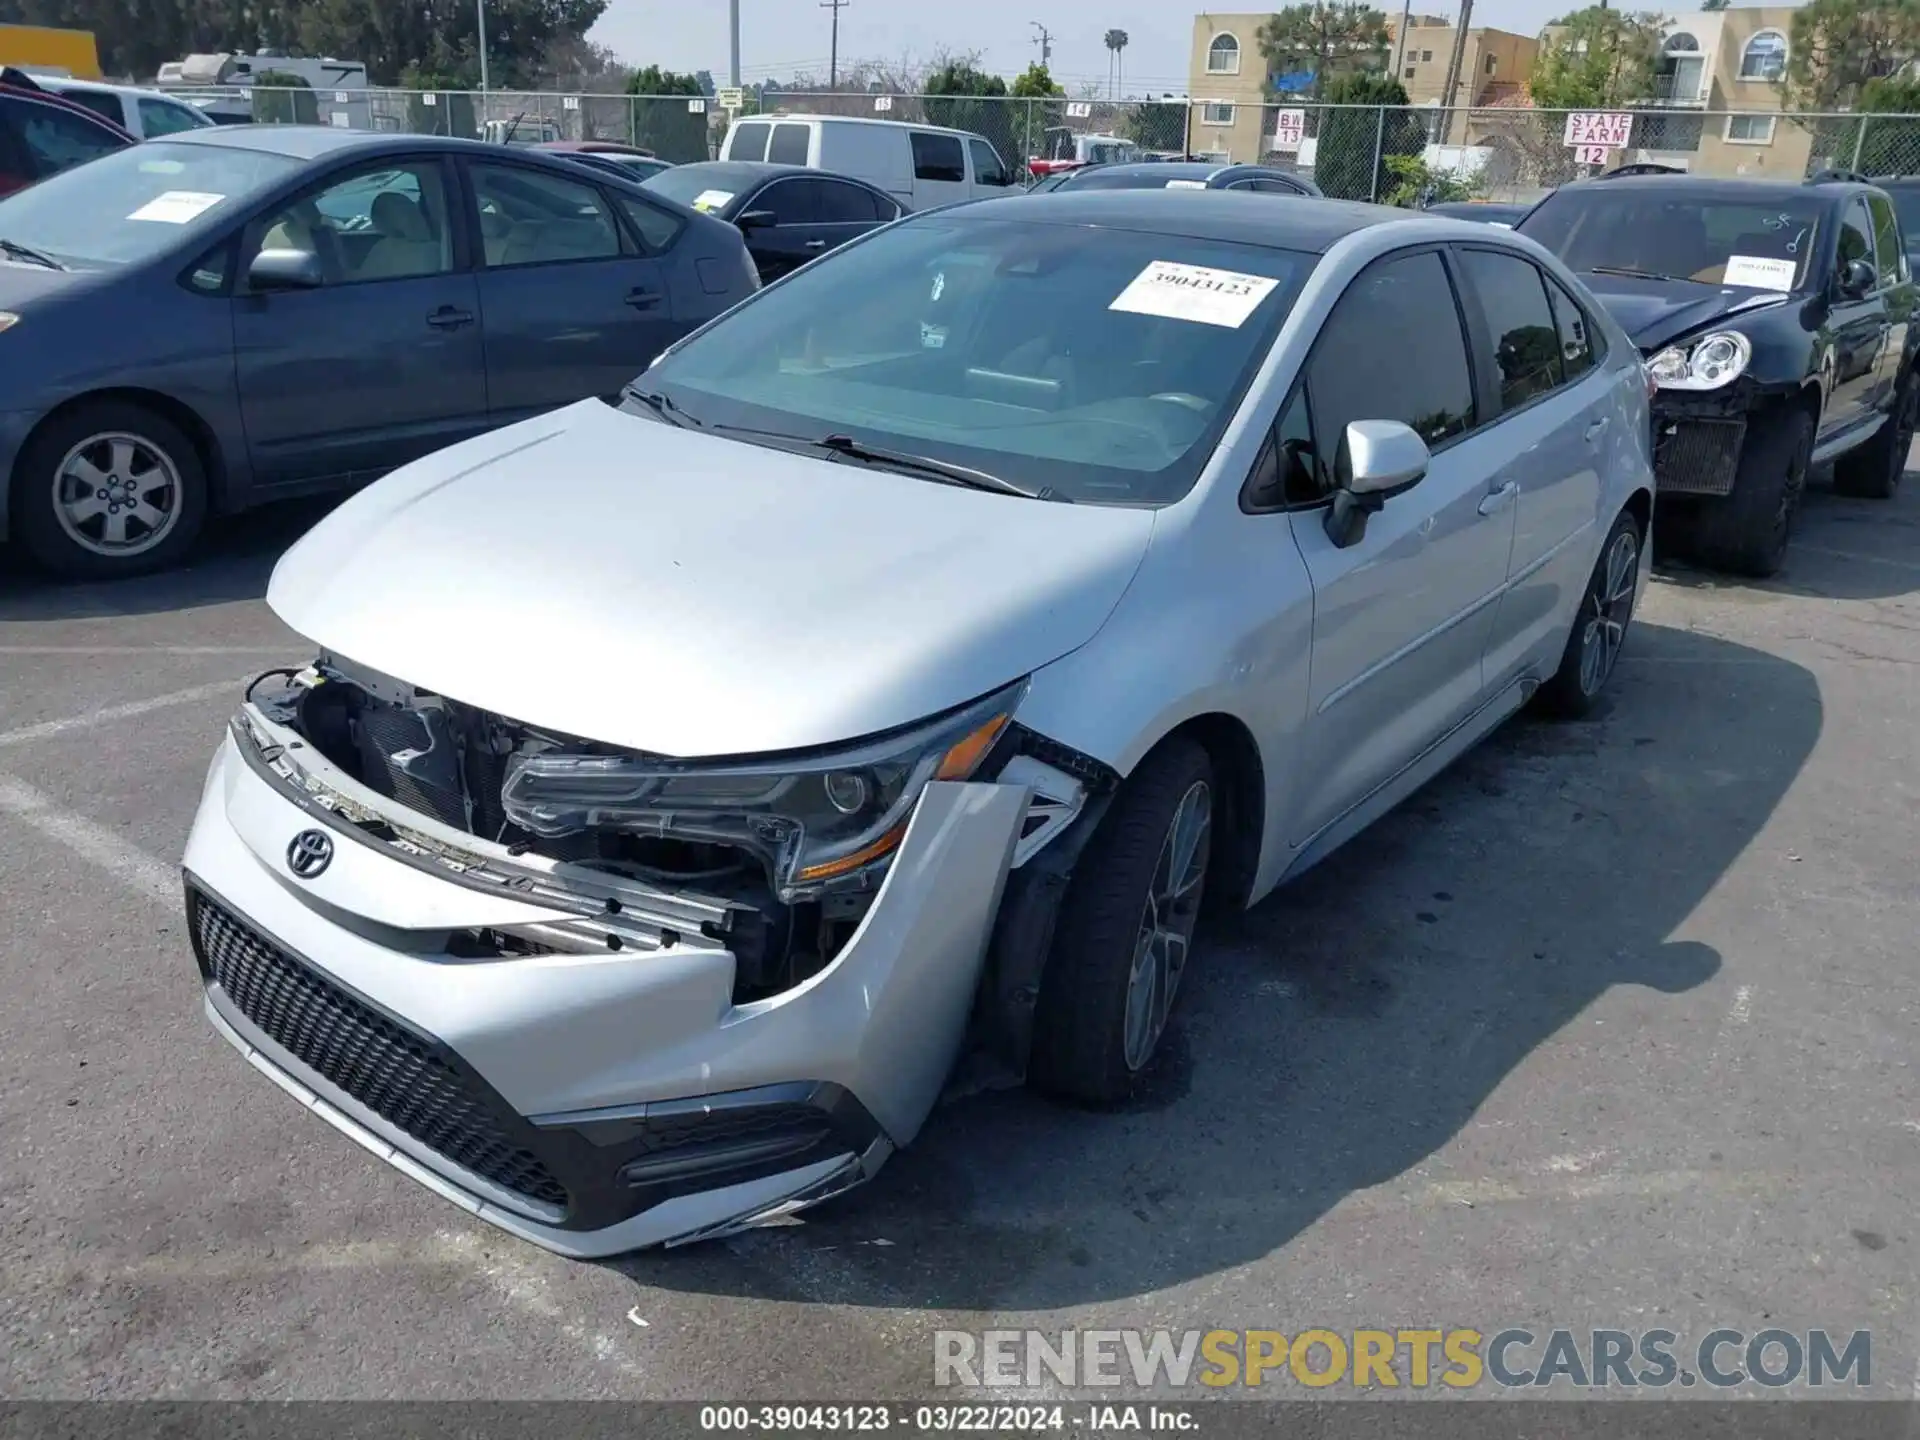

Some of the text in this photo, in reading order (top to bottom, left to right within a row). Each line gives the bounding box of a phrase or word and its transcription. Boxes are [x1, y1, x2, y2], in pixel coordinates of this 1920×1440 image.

[1281, 113, 1300, 126] BW
[1572, 114, 1629, 129] STATE
[1283, 130, 1298, 143] 13
[1571, 128, 1625, 142] FARM
[1583, 147, 1604, 163] 12
[1155, 272, 1252, 296] 39043123
